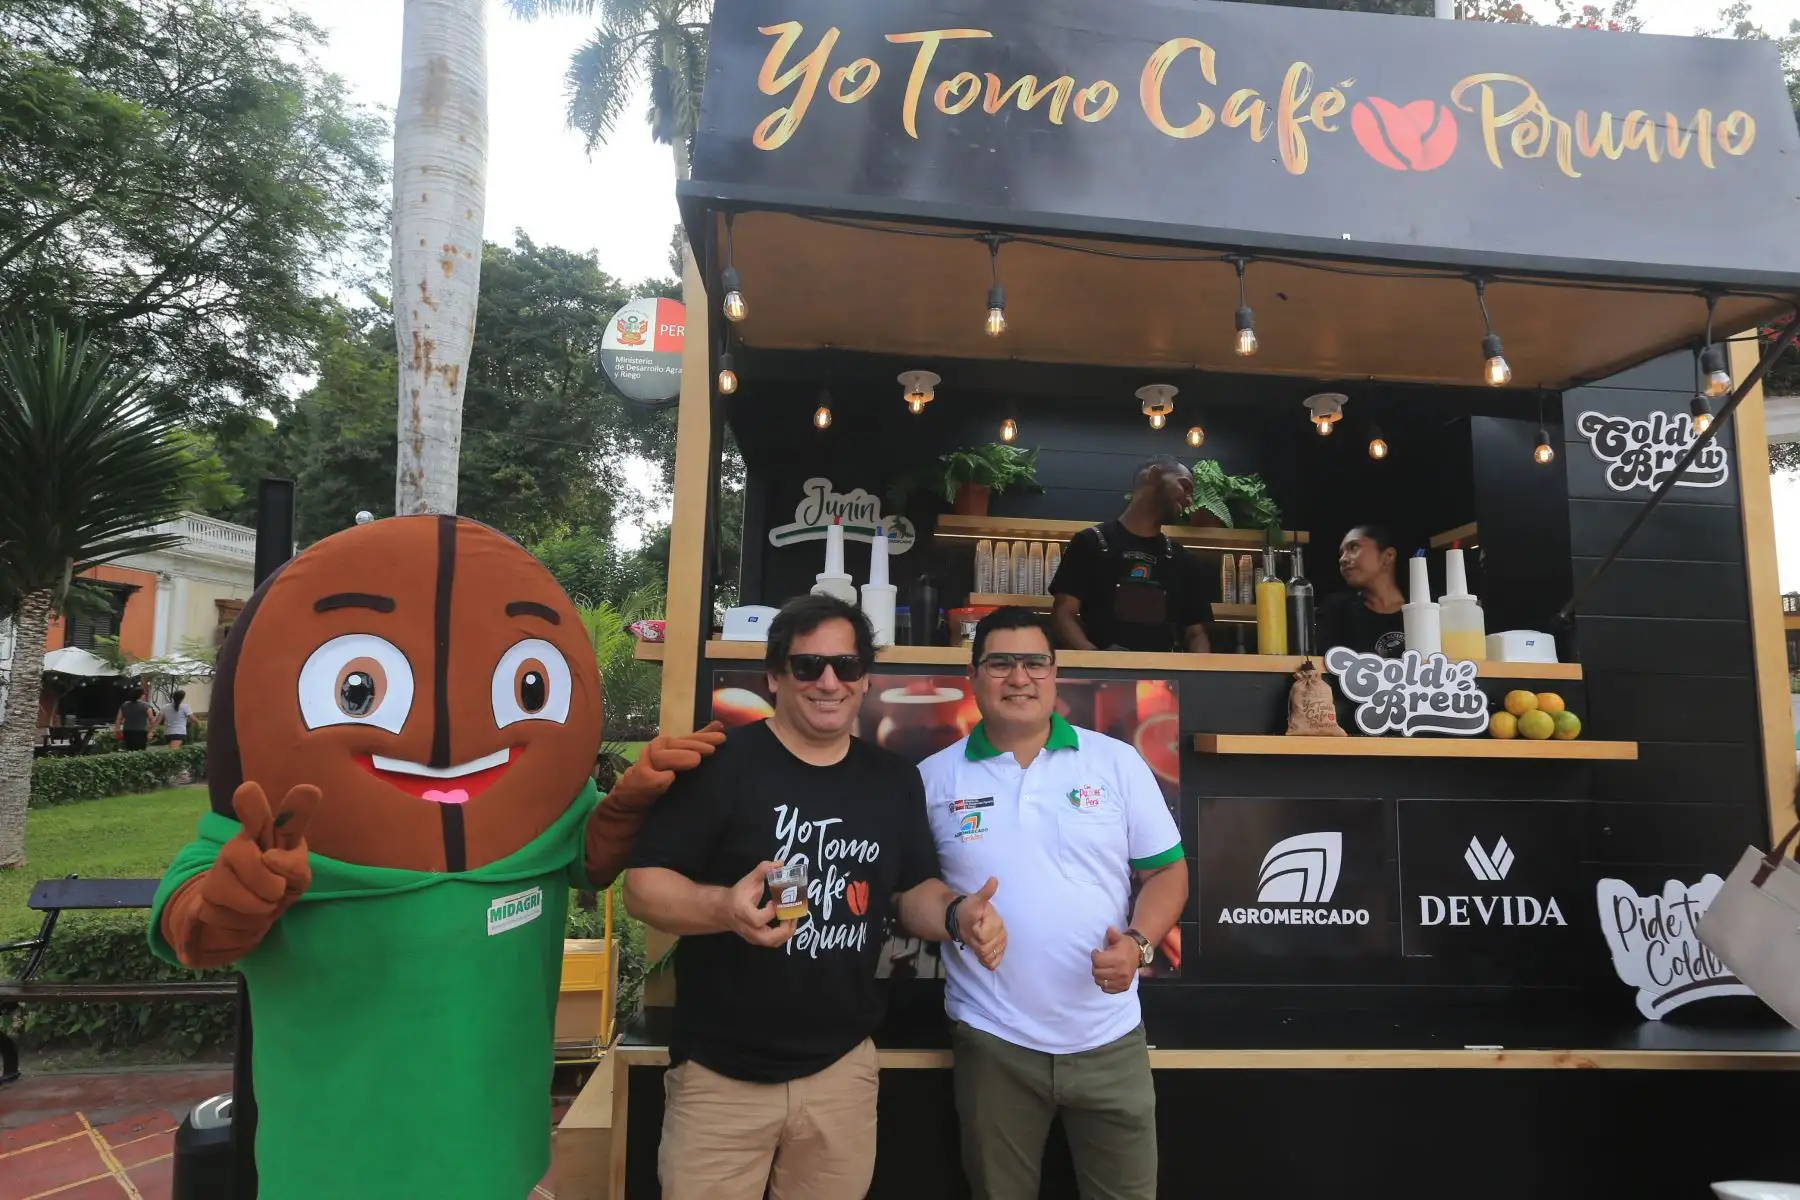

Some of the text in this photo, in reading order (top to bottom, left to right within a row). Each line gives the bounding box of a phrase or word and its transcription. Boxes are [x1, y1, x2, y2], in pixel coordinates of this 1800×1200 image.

[752, 20, 1756, 178] Yo Tomo Café Peruano
[615, 356, 653, 365] Ministerio
[626, 364, 664, 373] Desarrollo
[1581, 414, 1688, 457] Cold
[803, 485, 876, 527] Junín
[1330, 650, 1445, 698] Cold
[1360, 683, 1483, 731] Brew
[774, 804, 881, 872] Yo Tomo
[490, 893, 541, 923] MIDAGRI
[1217, 907, 1371, 926] AGROMERCADO
[1418, 895, 1569, 926] DEVIDA
[1612, 894, 1683, 953] Pide
